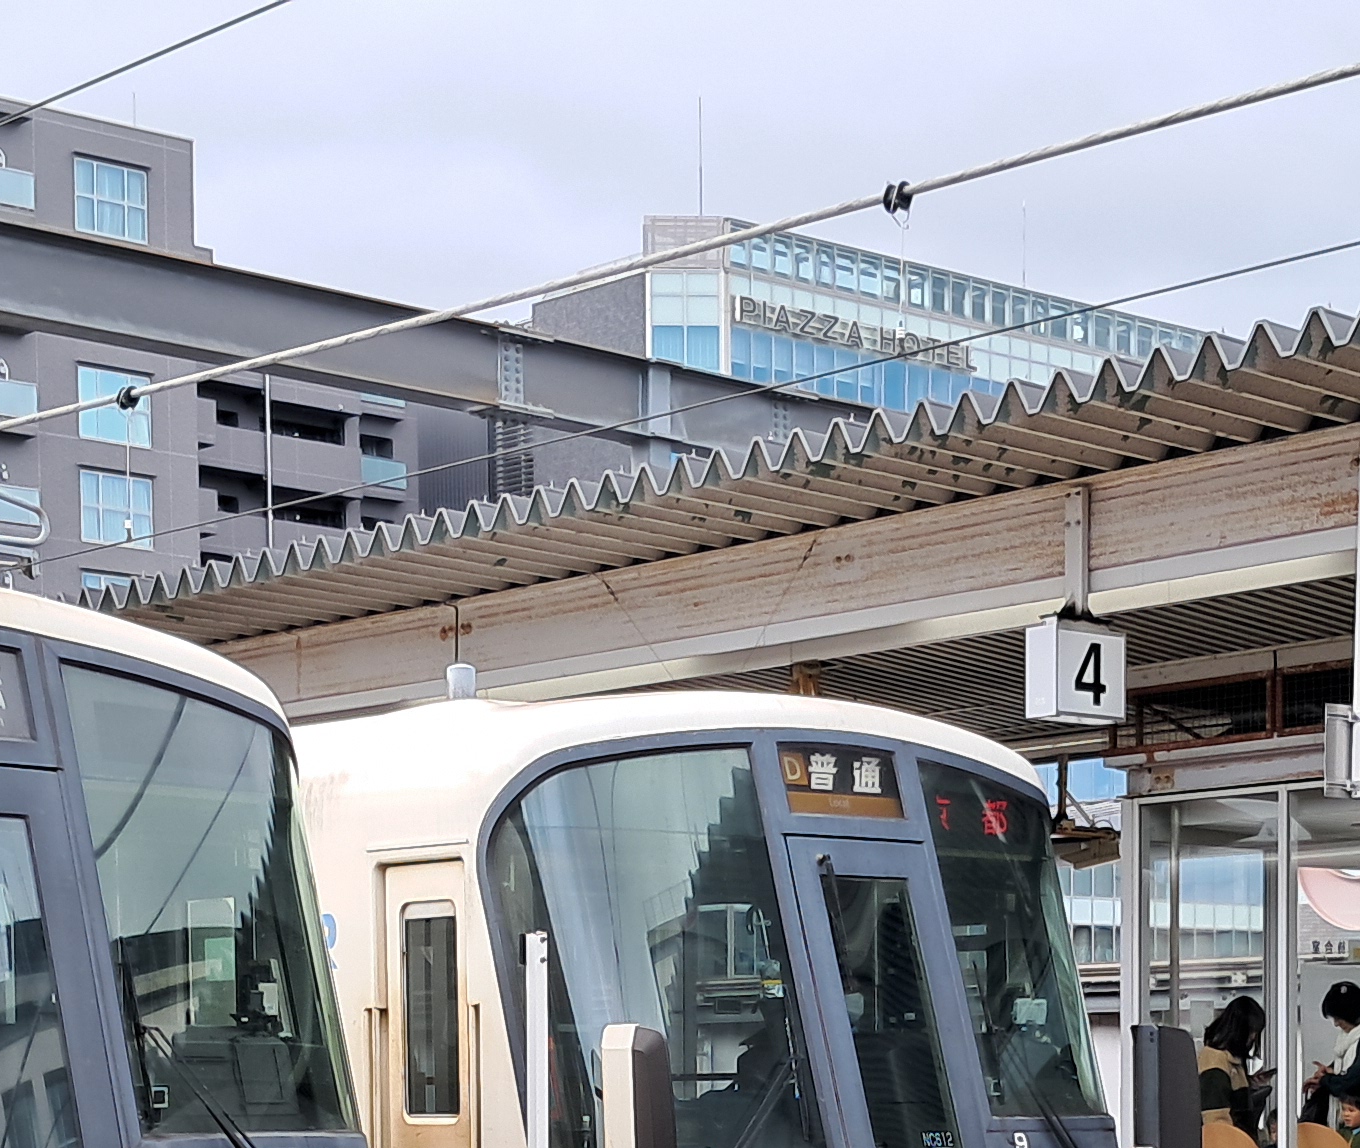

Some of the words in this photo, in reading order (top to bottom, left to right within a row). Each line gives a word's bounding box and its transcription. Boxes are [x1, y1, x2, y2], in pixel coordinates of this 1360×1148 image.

[735, 295, 864, 348] PIAZZA
[879, 325, 978, 373] HOTEL
[1074, 642, 1107, 707] 4
[783, 755, 802, 781] D
[807, 752, 882, 794] 普通
